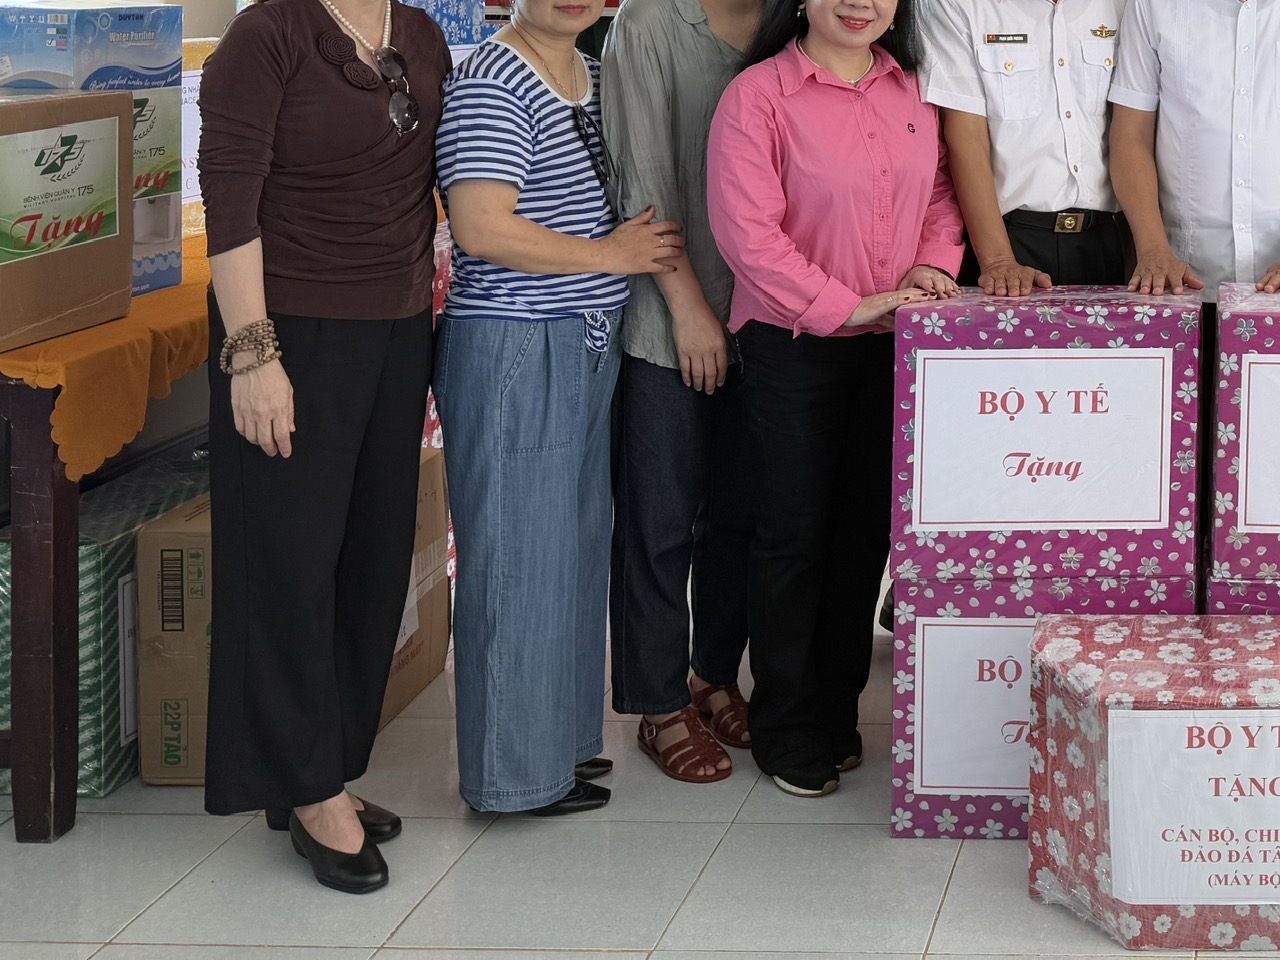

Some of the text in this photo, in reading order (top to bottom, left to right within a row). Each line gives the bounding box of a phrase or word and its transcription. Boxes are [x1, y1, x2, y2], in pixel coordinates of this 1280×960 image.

[109, 30, 156, 43] Water Purifier
[149, 146, 166, 158] 175
[77, 184, 94, 197] 175
[10, 208, 106, 251] Tặng
[977, 382, 1110, 422] BỘ Y TẾ
[1002, 450, 1085, 485] Tặng
[976, 655, 1022, 690] BỘ
[163, 701, 181, 737] 22P
[1001, 720, 1031, 745] T
[1184, 722, 1232, 756] BỘ
[1240, 725, 1265, 749] Y
[1161, 824, 1202, 843] CÁN
[1208, 826, 1240, 846] BỘ,
[1180, 845, 1222, 863] ĐẢO
[1227, 845, 1254, 863] ĐÁ
[1207, 869, 1255, 888] (MÁY
